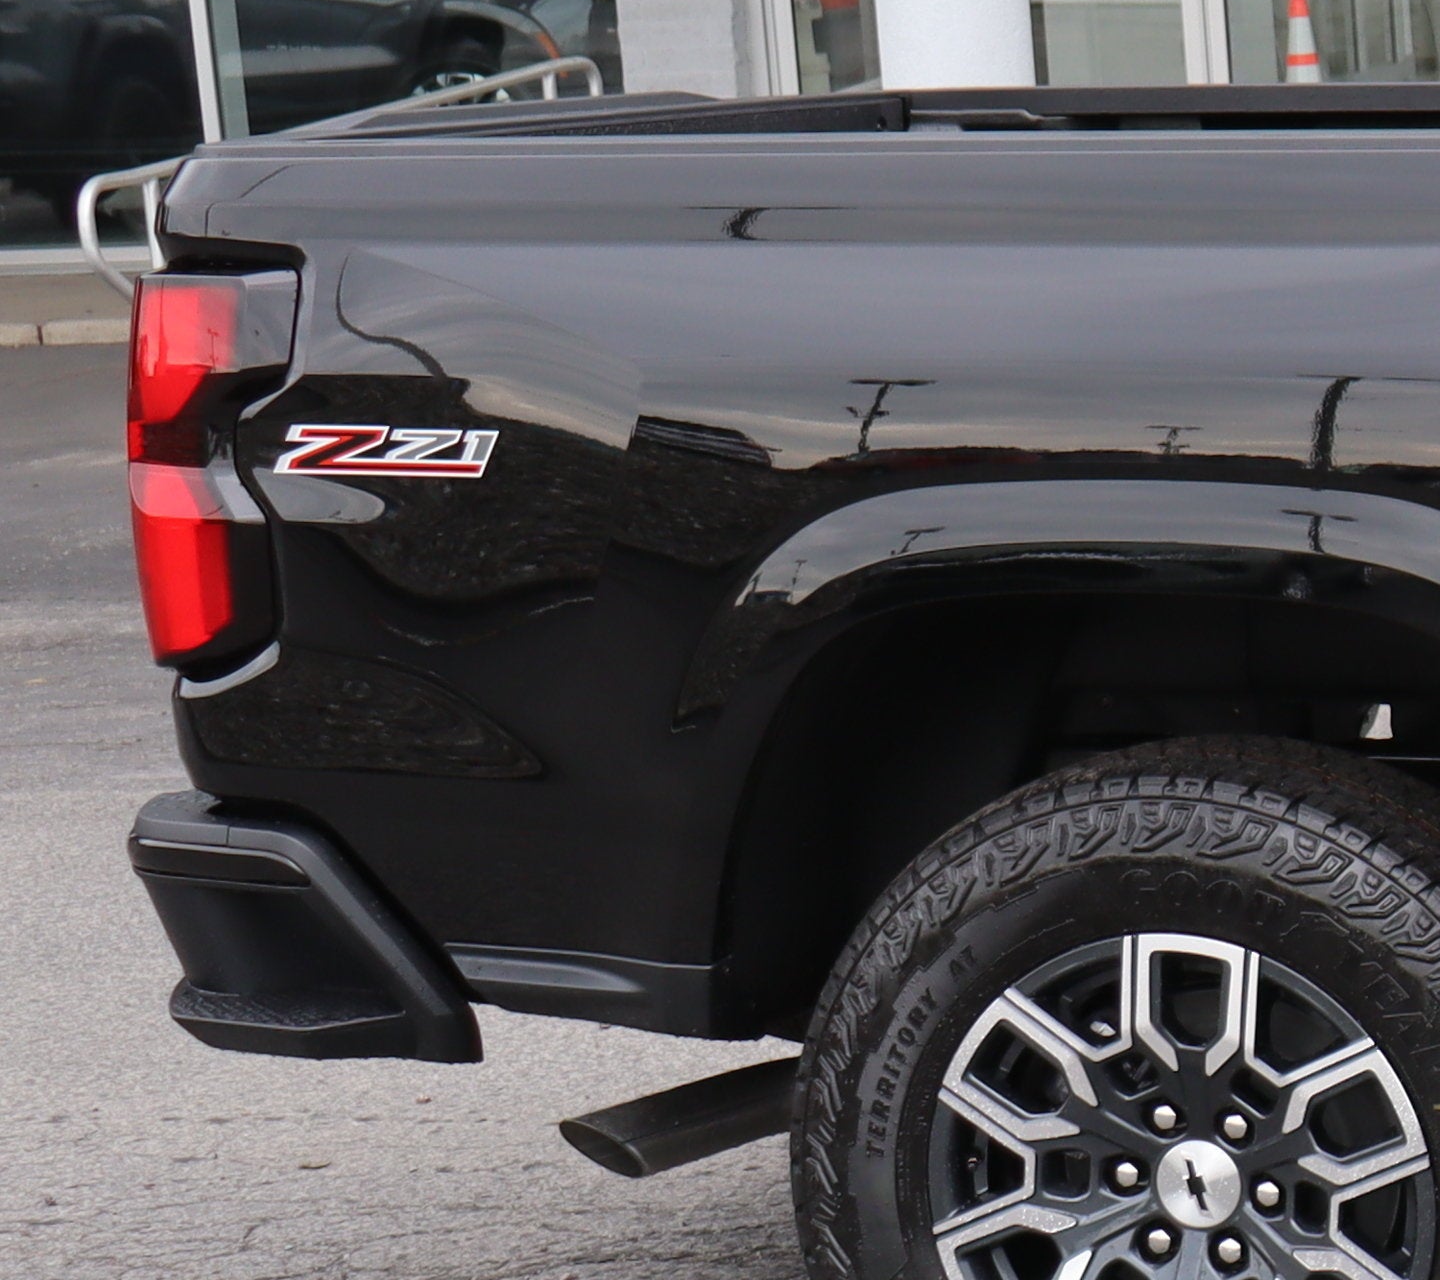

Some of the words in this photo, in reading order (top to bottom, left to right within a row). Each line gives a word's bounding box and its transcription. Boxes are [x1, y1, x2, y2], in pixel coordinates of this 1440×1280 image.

[273, 422, 500, 479] Z71
[865, 986, 937, 1159] TERRITORY
[949, 944, 977, 982] AT
